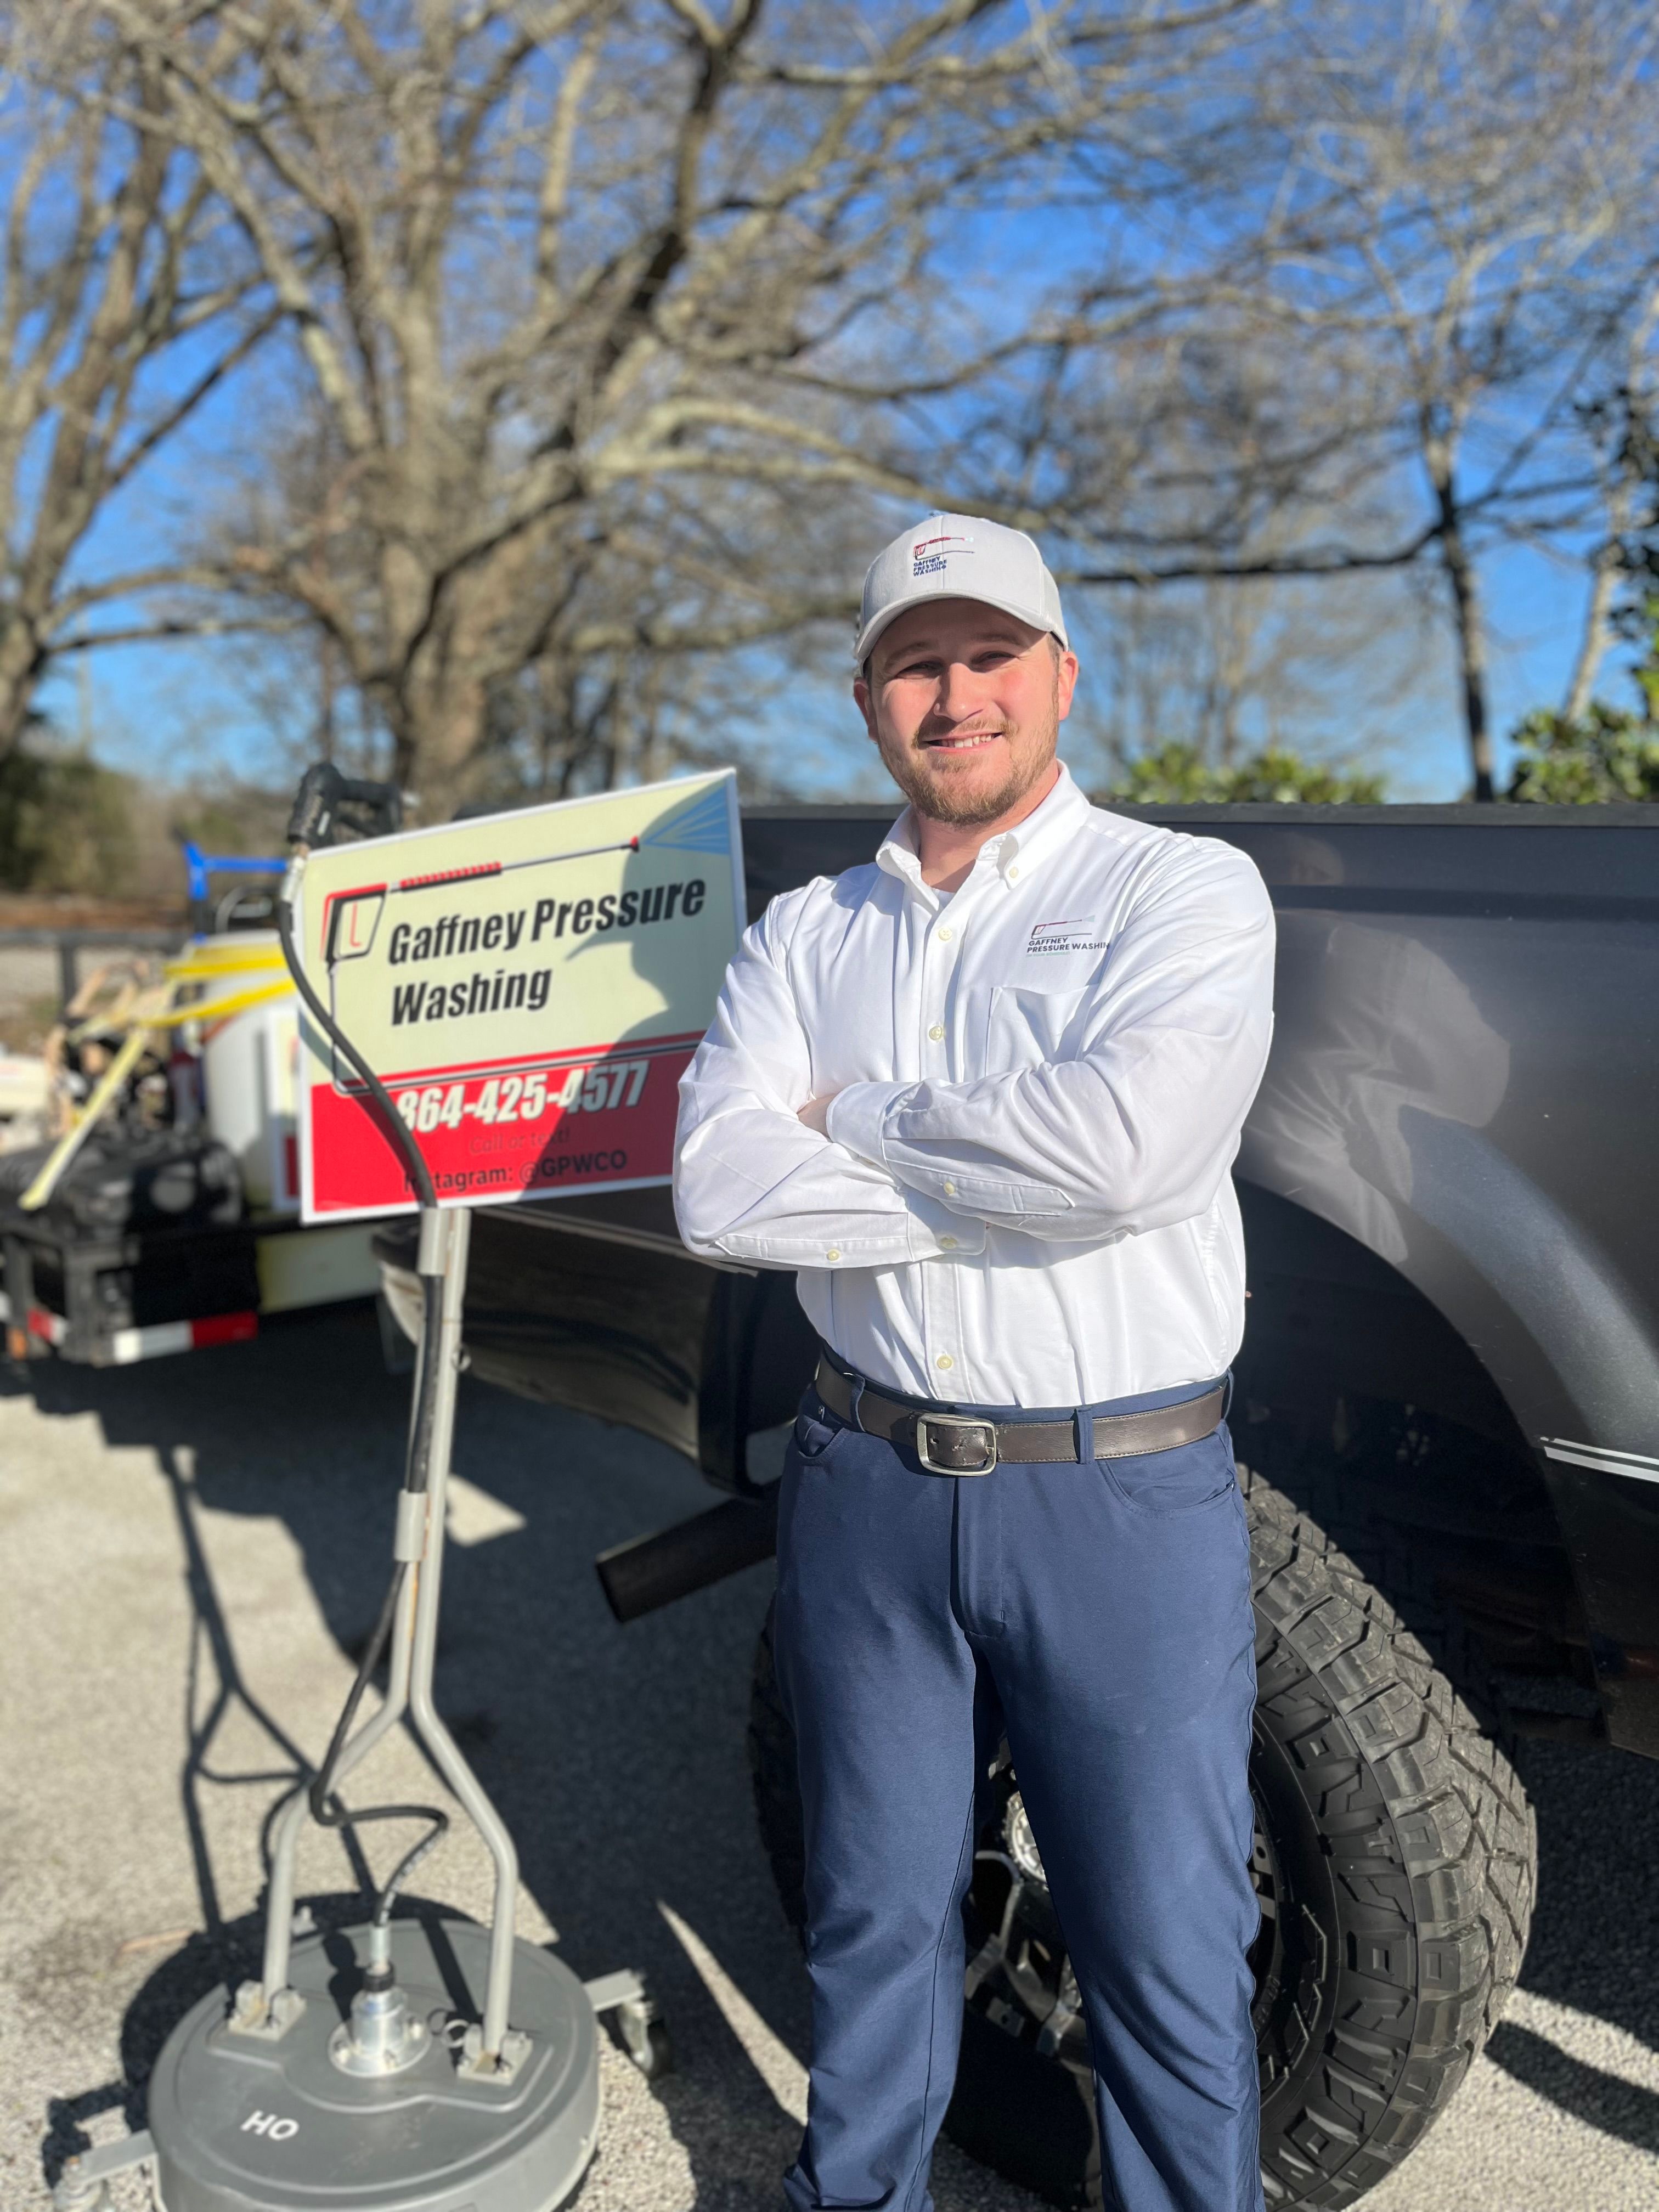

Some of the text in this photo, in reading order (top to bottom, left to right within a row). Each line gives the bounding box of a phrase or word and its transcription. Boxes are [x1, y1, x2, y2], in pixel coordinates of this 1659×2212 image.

[388, 878, 706, 965] Gaffney Pressure
[1027, 941, 1110, 953] PRESSURE WASHIN
[1029, 937, 1068, 946] GAFFNEY
[391, 968, 553, 1026] Washing
[397, 1059, 650, 1133] 864-425-4577
[469, 1127, 570, 1154] Call or text!
[520, 1150, 627, 1185] @GPWCO
